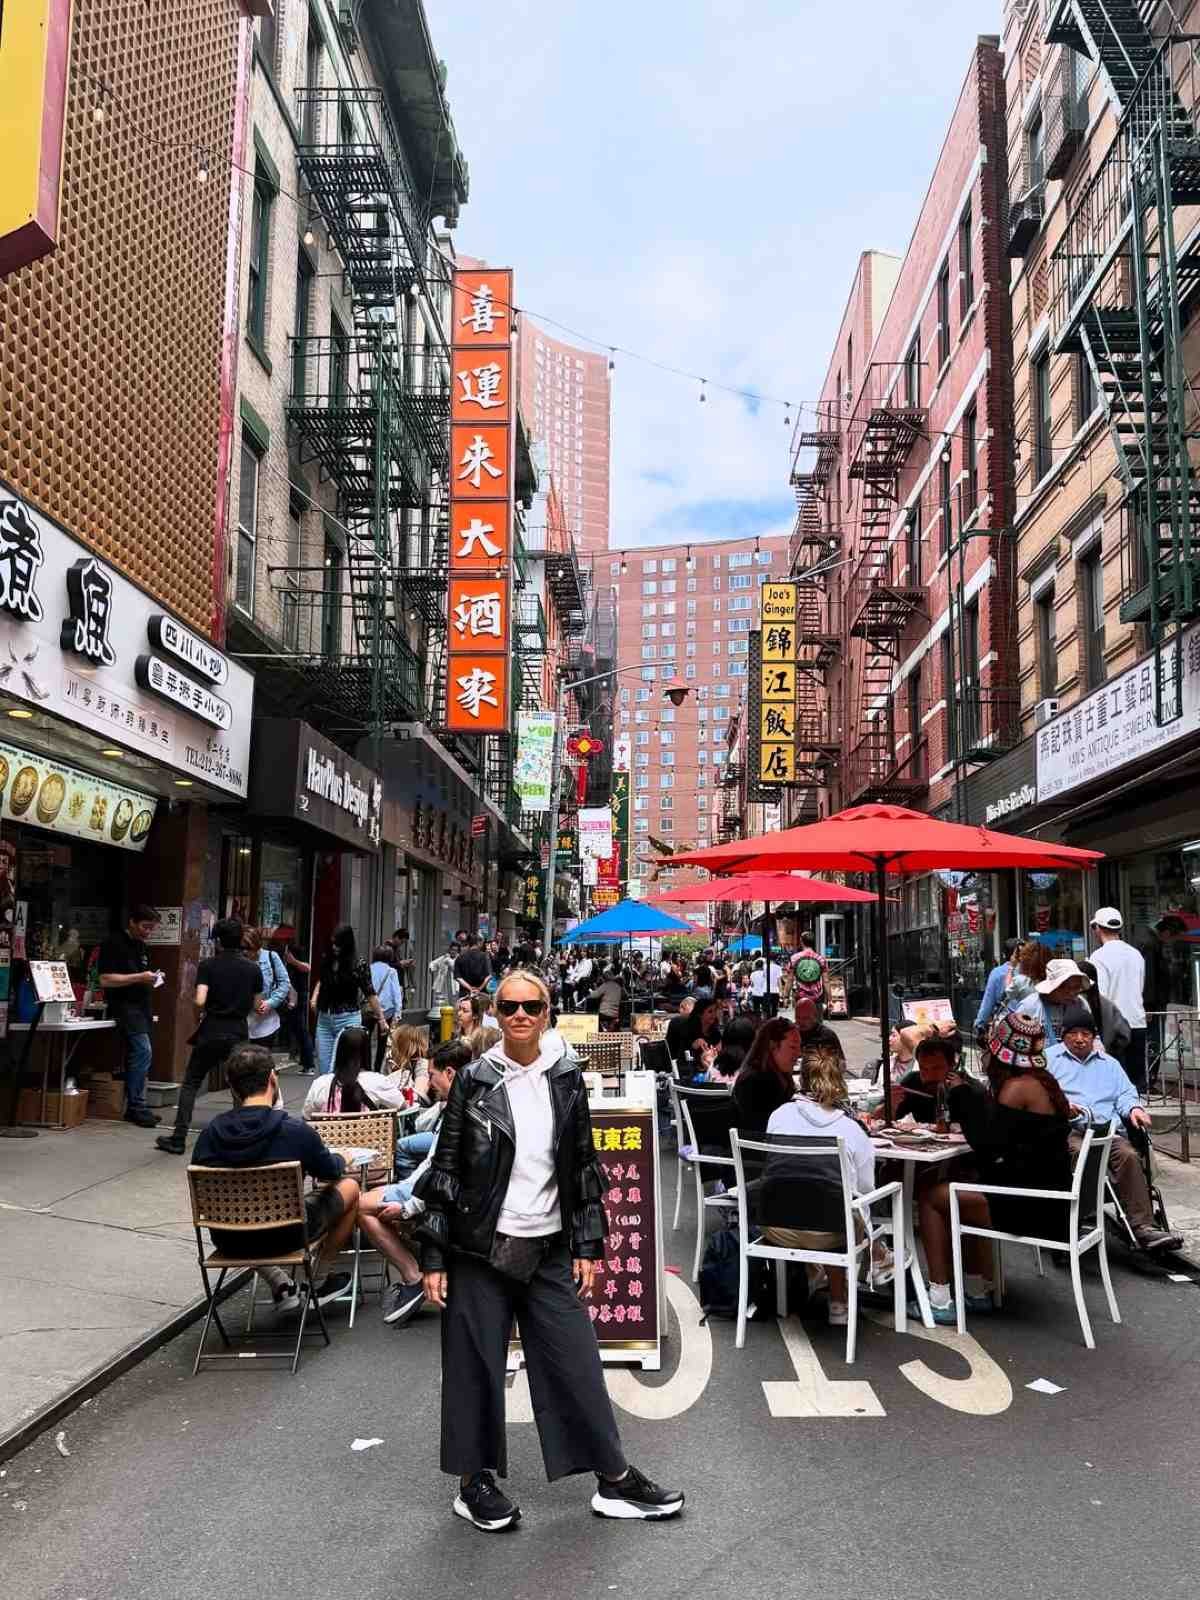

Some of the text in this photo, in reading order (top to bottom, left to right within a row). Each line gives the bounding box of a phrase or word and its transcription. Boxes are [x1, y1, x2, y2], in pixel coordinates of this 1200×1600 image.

[768, 587, 791, 600] Joe's
[764, 603, 795, 618] Ginger
[165, 623, 222, 679] 四川小炒
[765, 626, 793, 777] 錦江飯店
[1122, 711, 1156, 741] JEWELR
